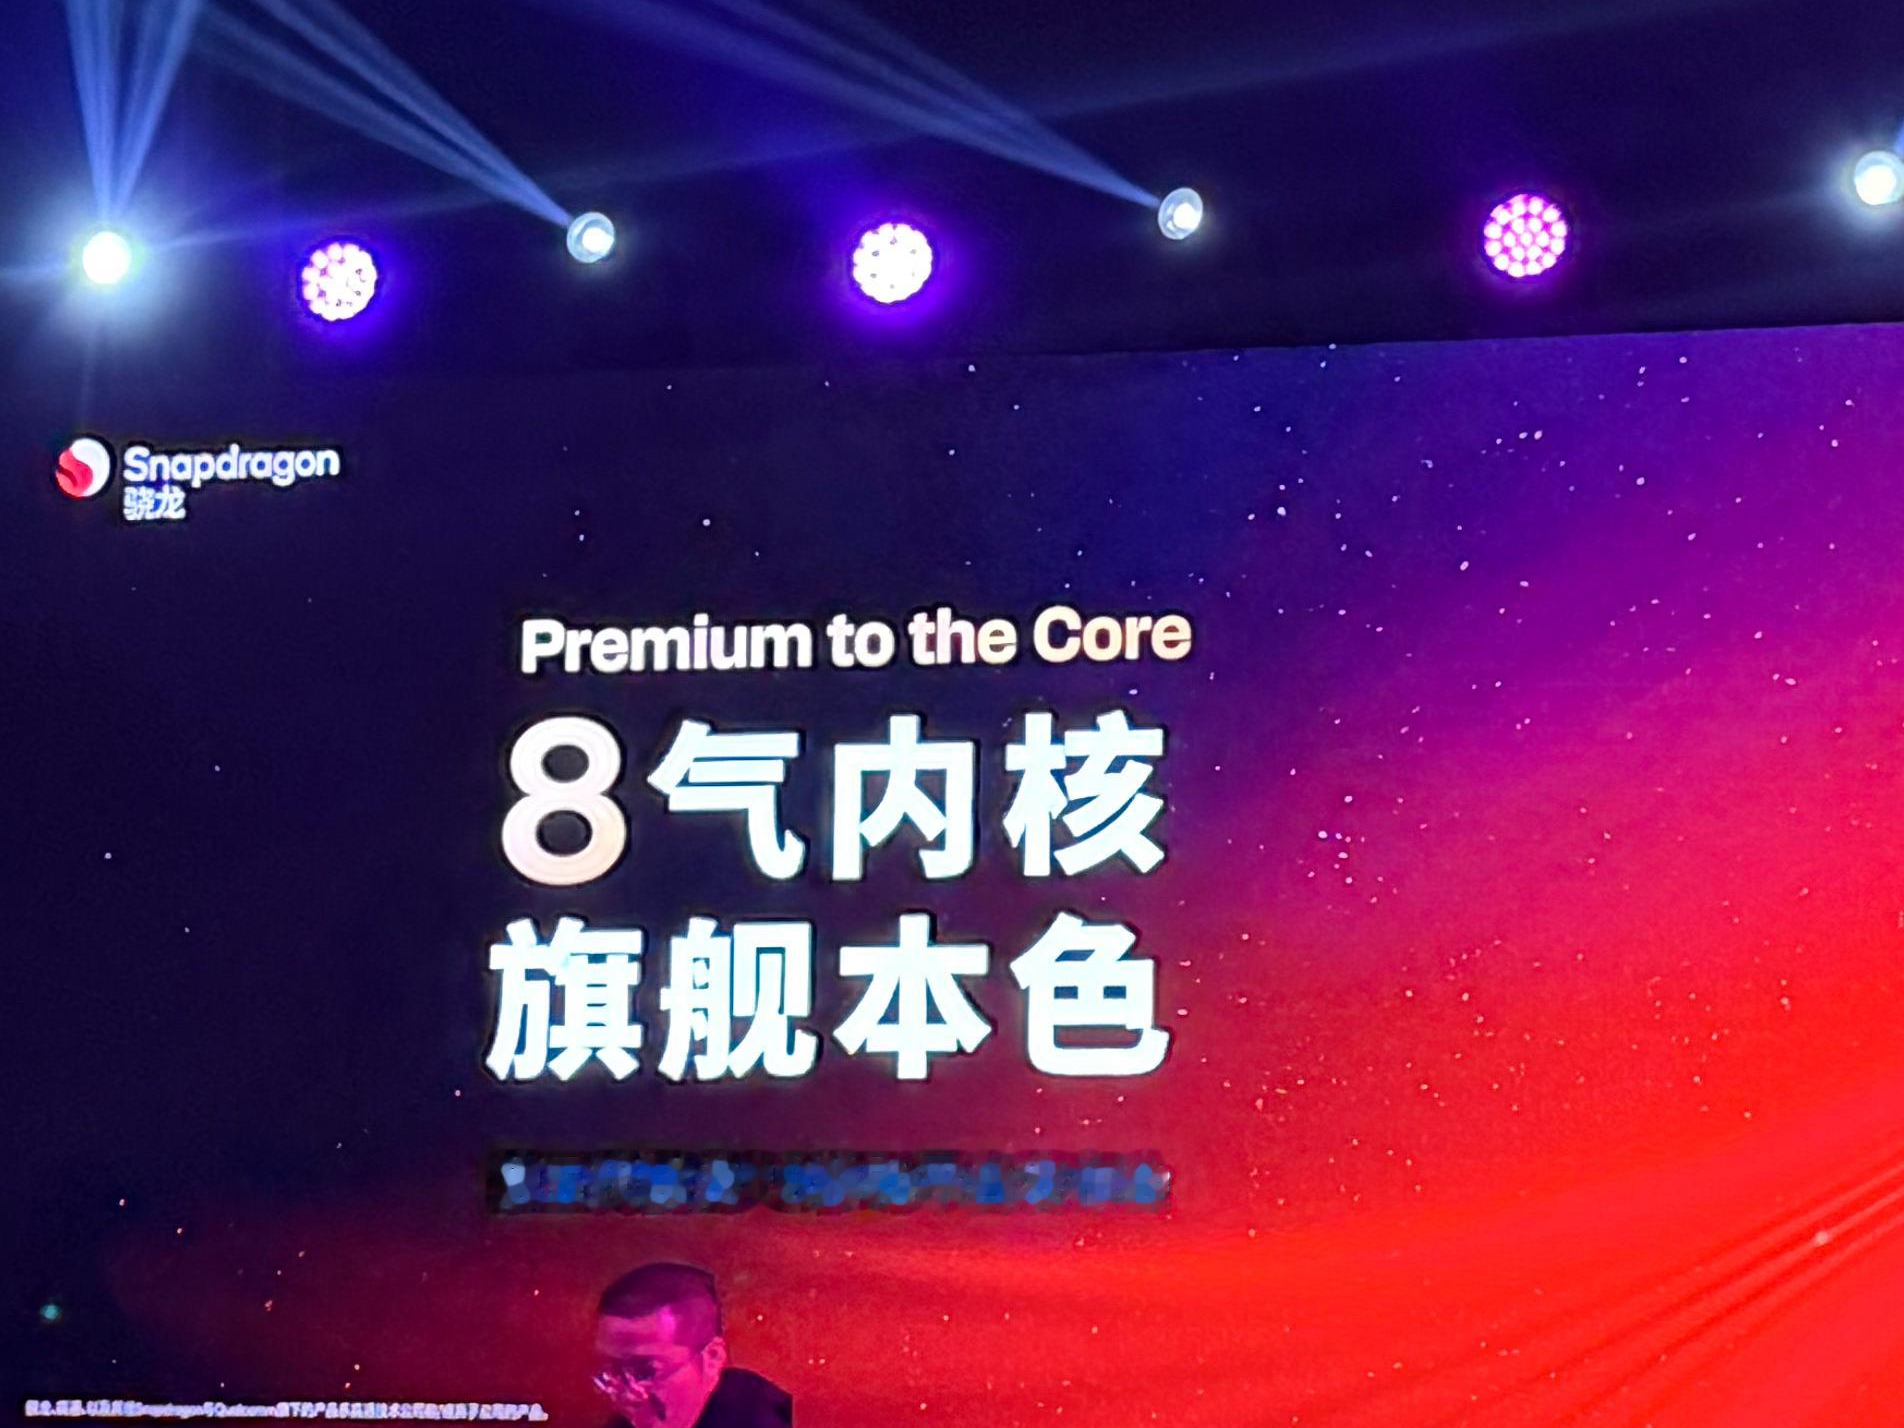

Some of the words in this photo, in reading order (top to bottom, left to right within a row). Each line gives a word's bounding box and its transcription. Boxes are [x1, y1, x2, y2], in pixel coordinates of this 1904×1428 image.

[123, 443, 341, 487] Snapdragon
[123, 485, 186, 521] 骁龙
[520, 614, 812, 673] Premium
[828, 614, 895, 667] to
[909, 607, 1017, 666] the
[1032, 606, 1193, 663] Core
[501, 710, 1166, 886] 8气内核
[486, 912, 1170, 1080] 旗舰本色
